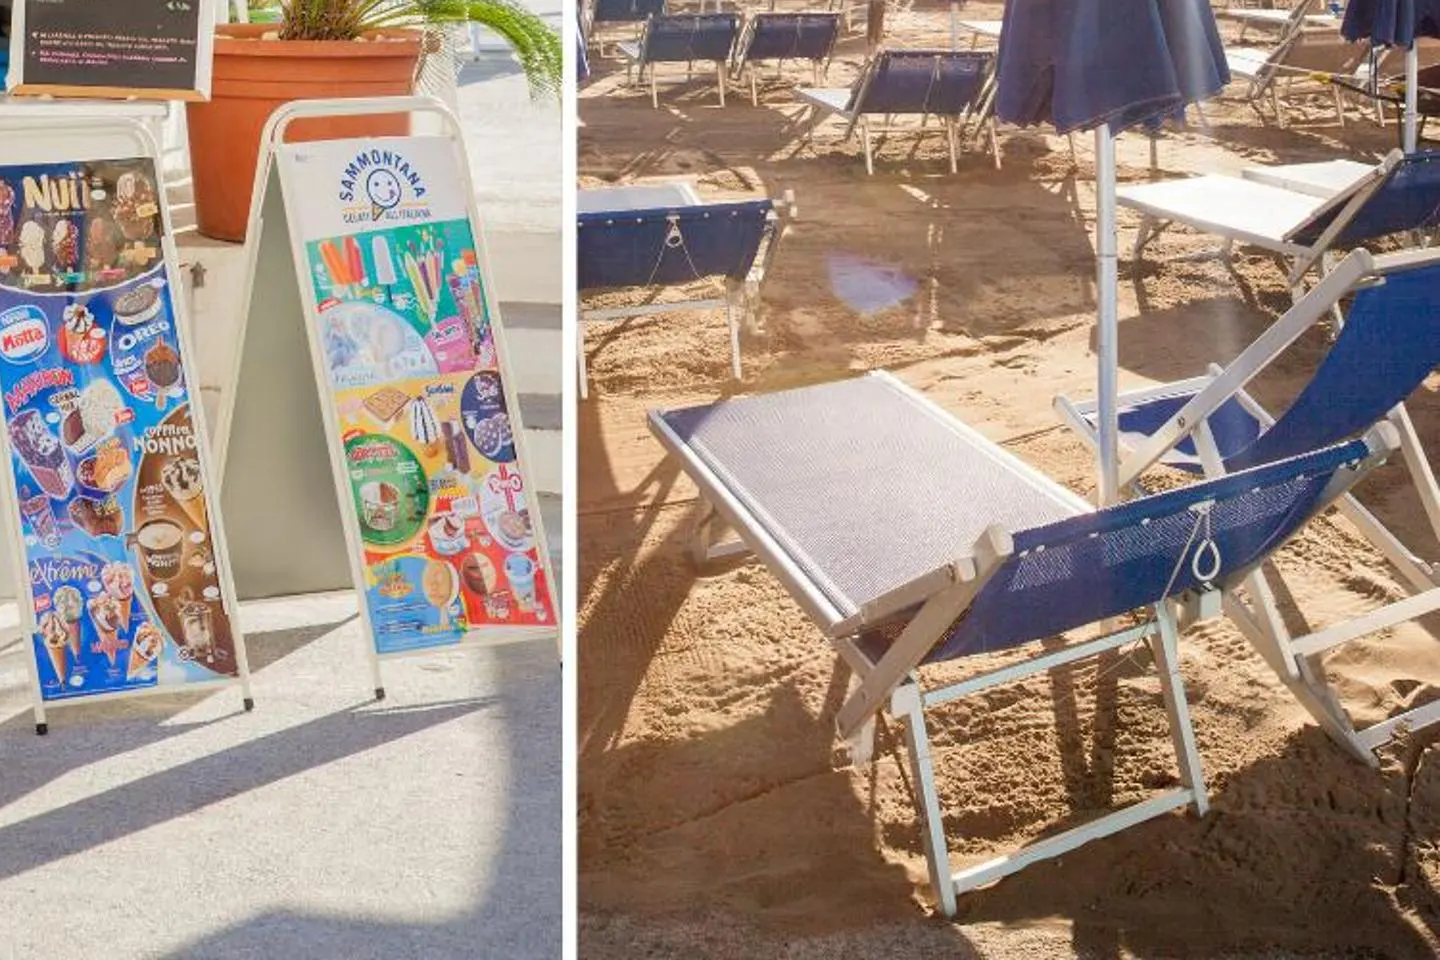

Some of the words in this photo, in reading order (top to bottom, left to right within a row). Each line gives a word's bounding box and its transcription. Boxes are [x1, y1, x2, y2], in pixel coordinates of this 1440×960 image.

[339, 148, 427, 202] SAMMONTANA
[2, 327, 45, 353] Motta
[118, 321, 170, 351] OREO
